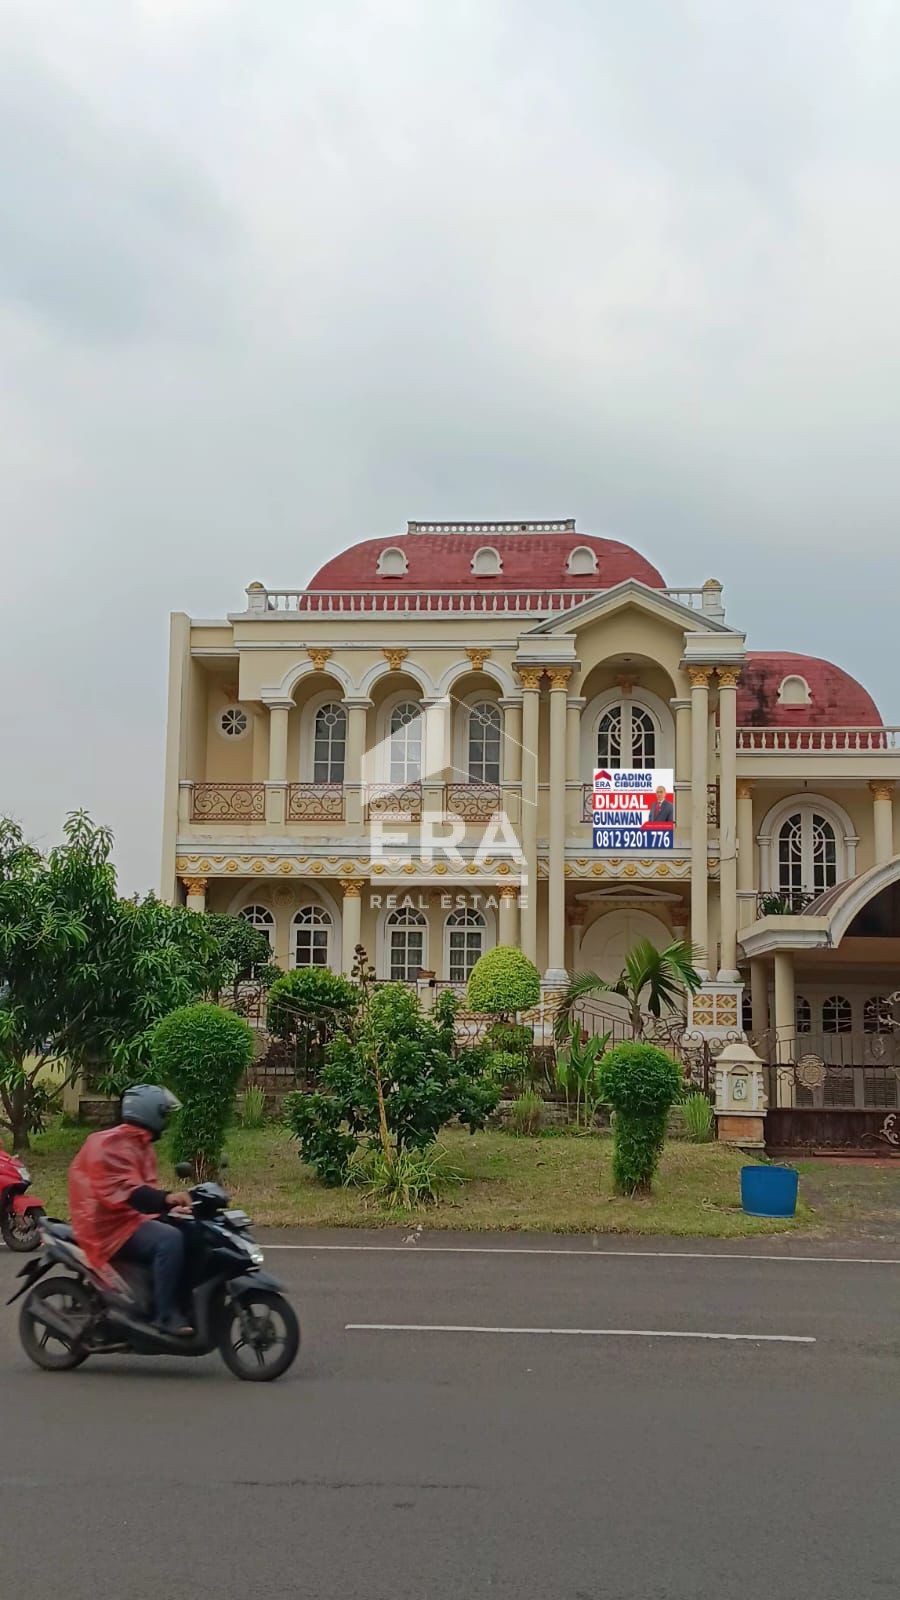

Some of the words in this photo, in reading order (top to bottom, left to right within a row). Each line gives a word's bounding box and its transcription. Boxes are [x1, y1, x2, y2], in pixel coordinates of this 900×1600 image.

[614, 773, 652, 781] GADING
[595, 794, 648, 809] DIJUAL
[593, 811, 643, 826] GUNAWAN
[596, 831, 621, 847] 0812
[623, 831, 648, 847] 9201
[651, 831, 670, 848] 776
